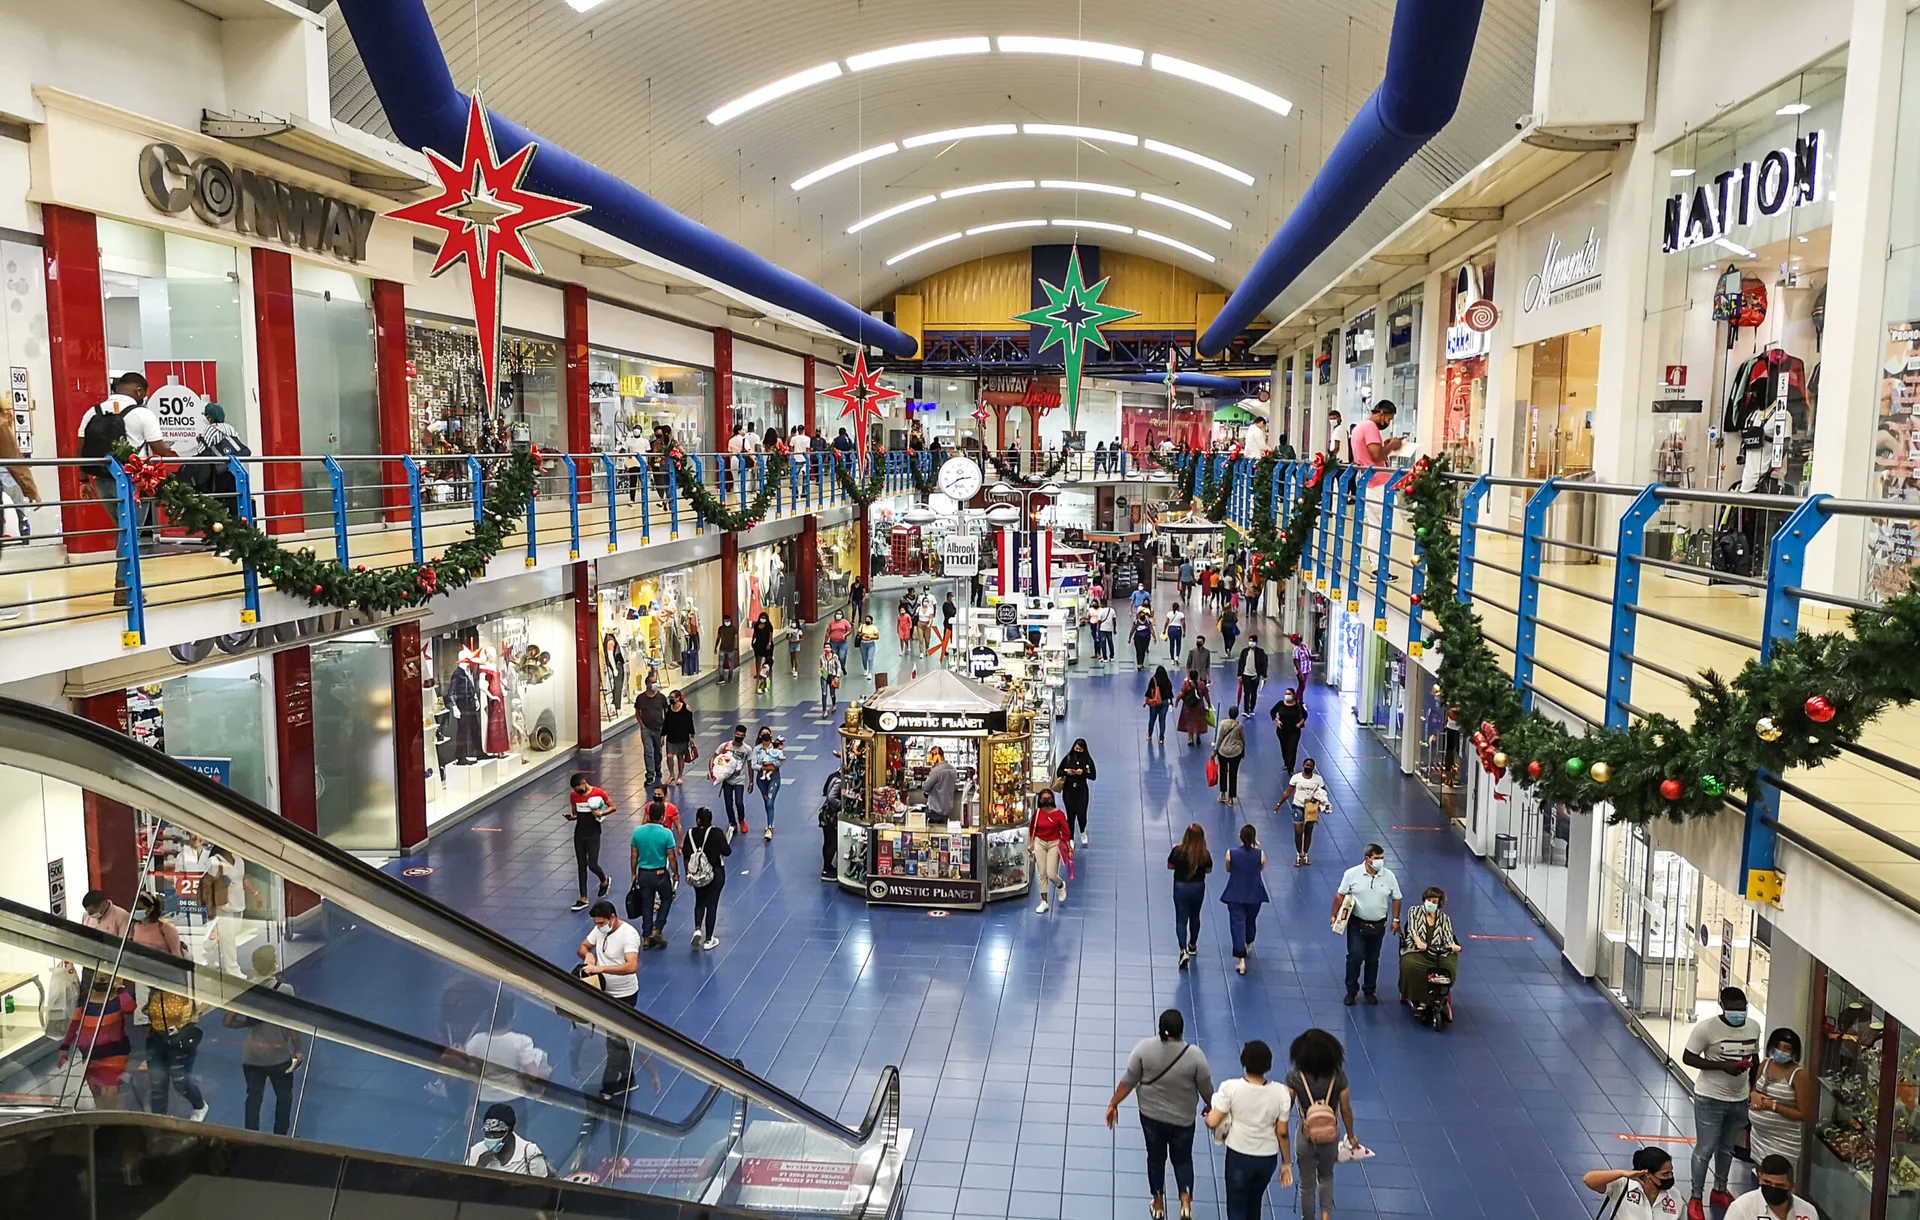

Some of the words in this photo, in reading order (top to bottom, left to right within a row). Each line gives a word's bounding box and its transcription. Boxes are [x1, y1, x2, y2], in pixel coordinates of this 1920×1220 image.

[1663, 128, 1826, 254] NATION
[139, 142, 376, 266] CONWAY
[13, 373, 26, 383] 500
[982, 376, 1028, 393] CONWAY
[159, 396, 194, 415] 50%
[159, 416, 195, 426] MENOS
[947, 542, 976, 554] Albrook
[946, 553, 976, 565] mall
[898, 716, 940, 728] MYSTIC
[941, 717, 985, 728] PLANET
[50, 864, 63, 877] 500
[889, 885, 930, 897] MYSTIC
[932, 887, 975, 900] PLANET
